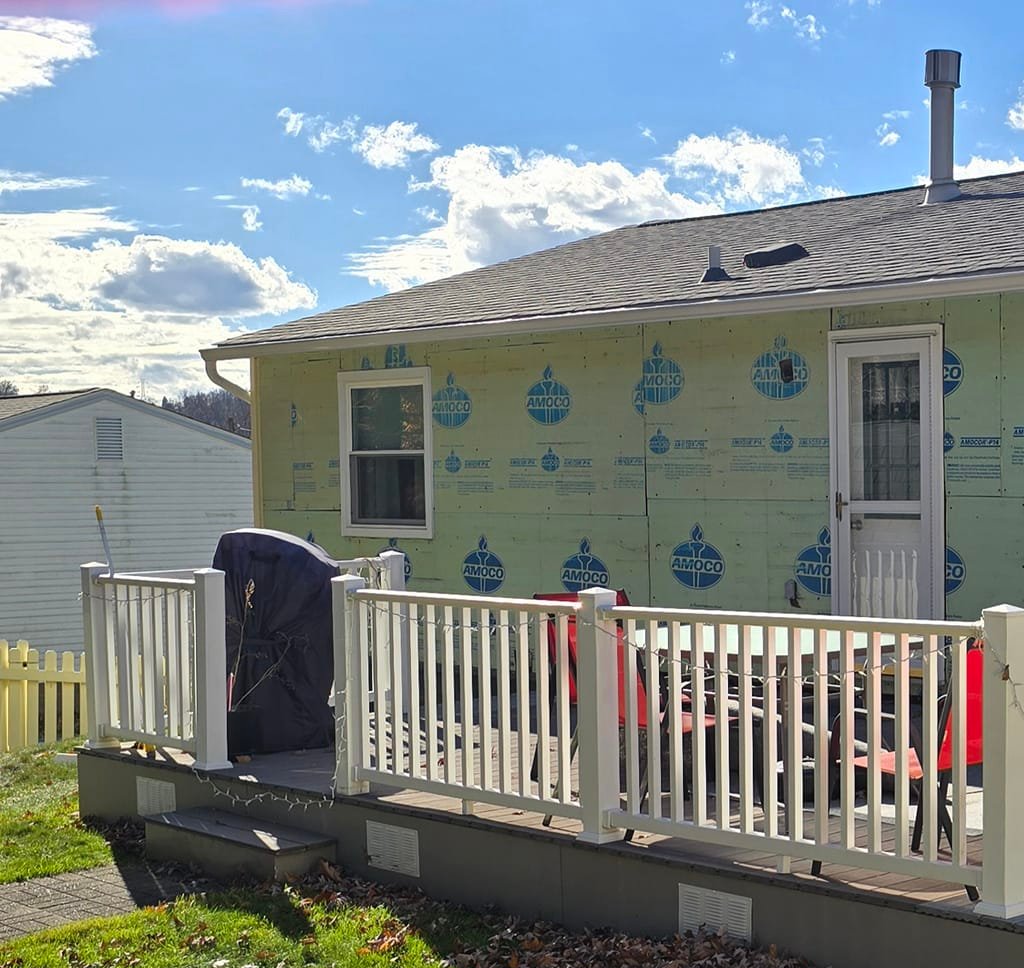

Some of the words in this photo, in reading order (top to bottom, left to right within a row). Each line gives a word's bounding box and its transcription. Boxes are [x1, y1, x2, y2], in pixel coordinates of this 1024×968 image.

[643, 374, 682, 387] MOCO
[432, 402, 470, 413] AMOCO
[527, 397, 570, 408] AMOCO
[463, 565, 504, 579] AMOCO
[672, 558, 723, 573] AMOCO
[796, 563, 831, 577] AMO
[562, 569, 608, 585] AMOCO
